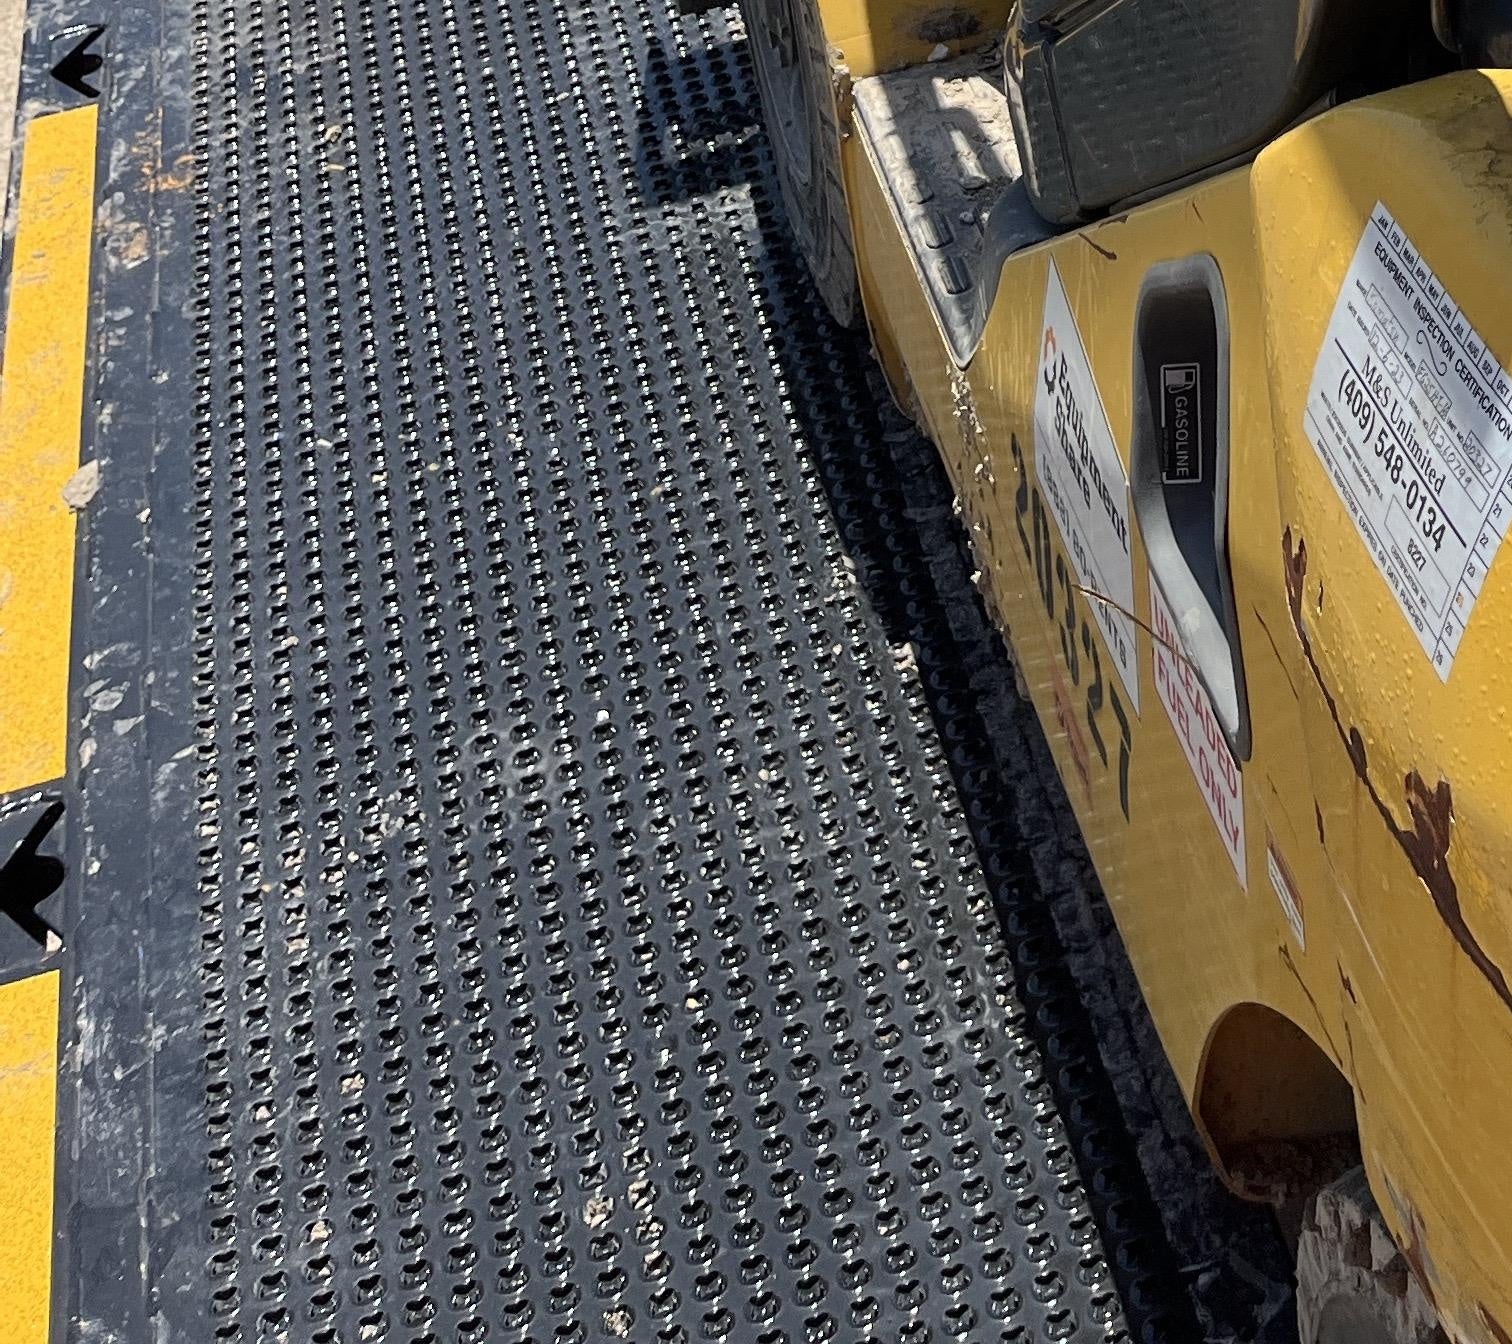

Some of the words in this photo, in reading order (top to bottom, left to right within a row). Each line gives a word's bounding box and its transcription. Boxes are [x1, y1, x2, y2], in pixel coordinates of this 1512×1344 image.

[1373, 239, 1415, 303] EQUIPMENT
[1412, 295, 1456, 362] INSPECTION
[1390, 229, 1401, 249] FEB
[1466, 337, 1480, 361] AUG
[1481, 357, 1493, 378] SEP
[1496, 377, 1509, 400] OCT
[1052, 397, 1092, 511] Share
[1057, 350, 1130, 556] Equipment
[1174, 395, 1191, 477] GASOLINE
[1335, 366, 1377, 447] (409)
[1373, 424, 1447, 555] 548-0134
[1361, 355, 1391, 410] M&S
[1389, 399, 1446, 496] Unlimited
[1479, 531, 1489, 550] 22
[1492, 501, 1502, 520] 21
[1011, 431, 1132, 825] 20327
[1153, 590, 1237, 804] UNLEADED
[1157, 646, 1195, 759] FUEL
[1198, 738, 1239, 856] ONLY
